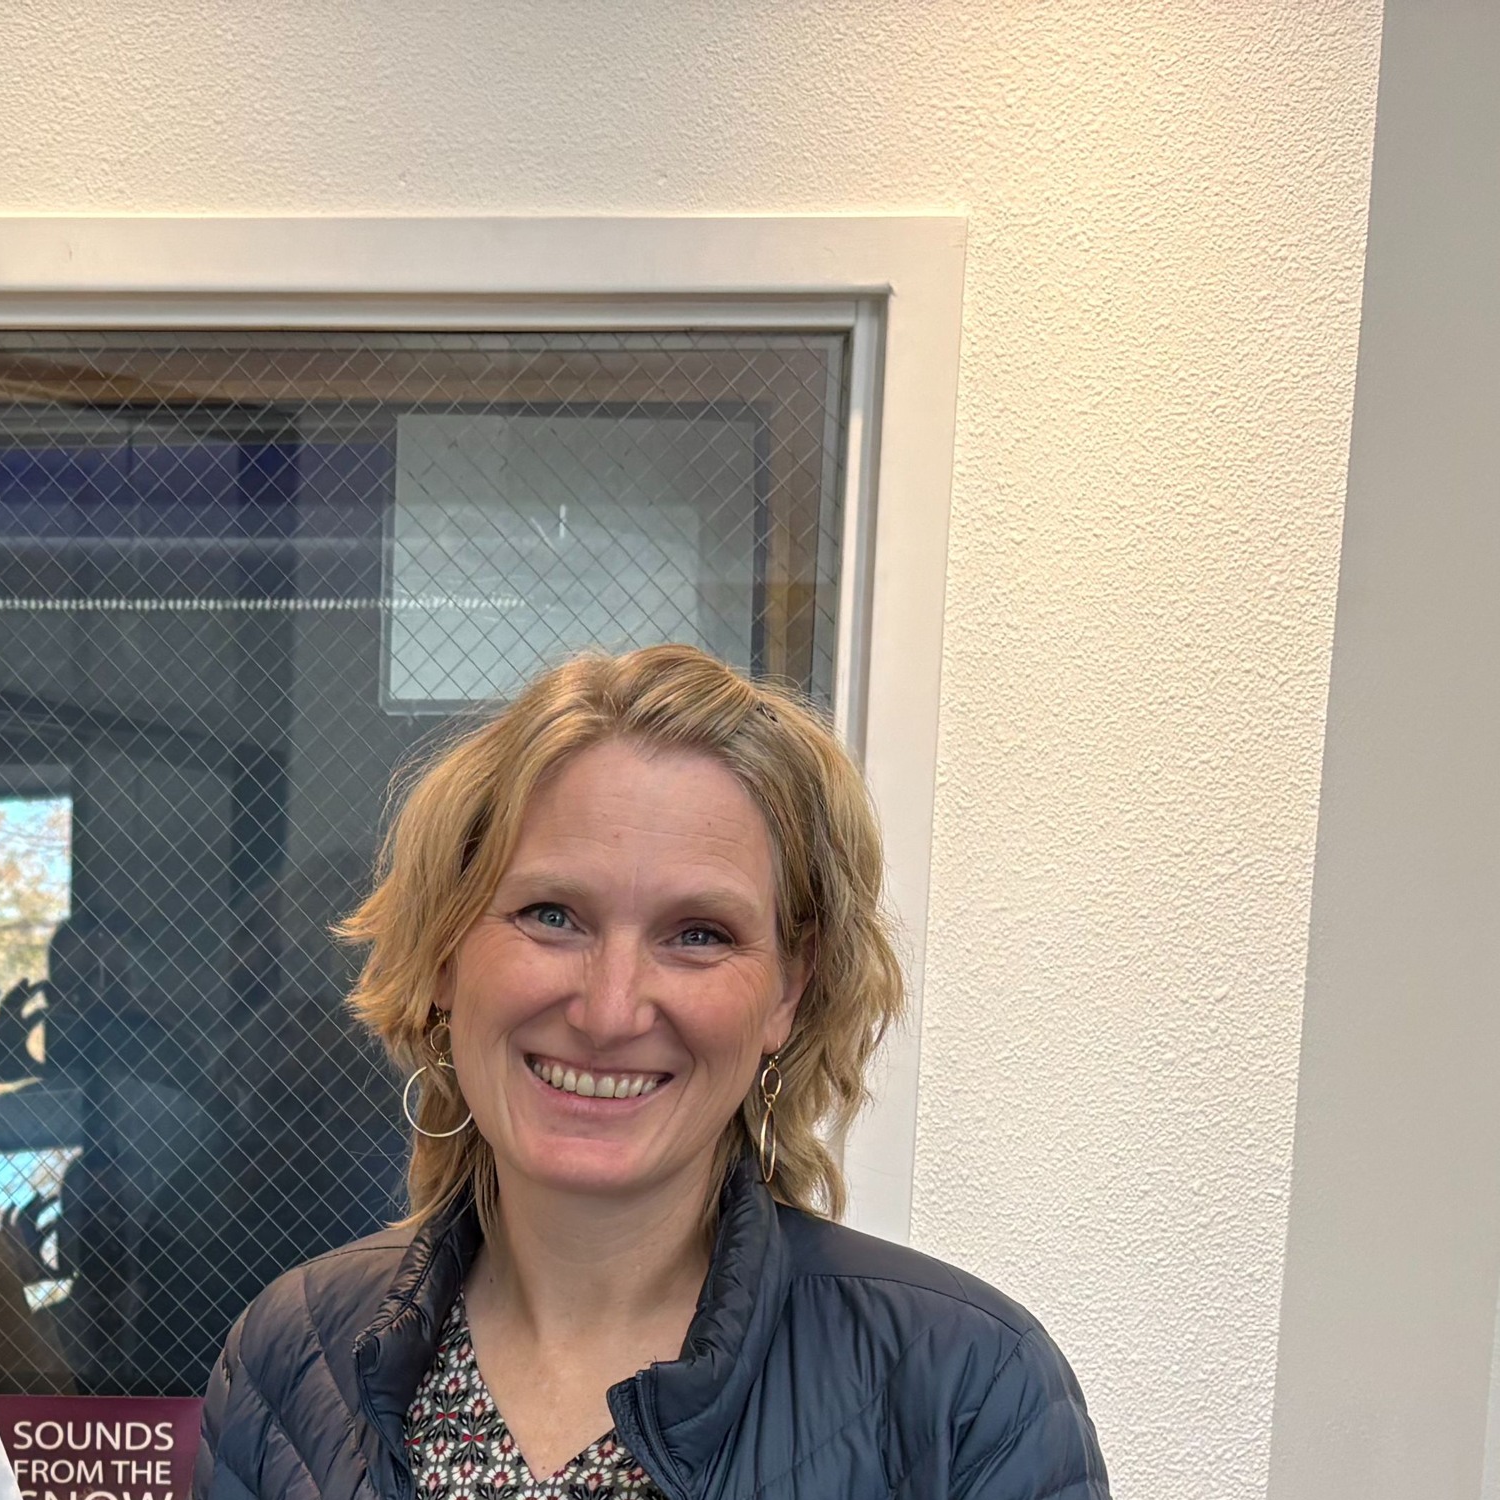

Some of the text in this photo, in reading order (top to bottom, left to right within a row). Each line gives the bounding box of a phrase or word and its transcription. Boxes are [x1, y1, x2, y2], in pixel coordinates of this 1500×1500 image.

[13, 1421, 174, 1451] SOUNDS
[14, 1459, 172, 1485] FROM THE
